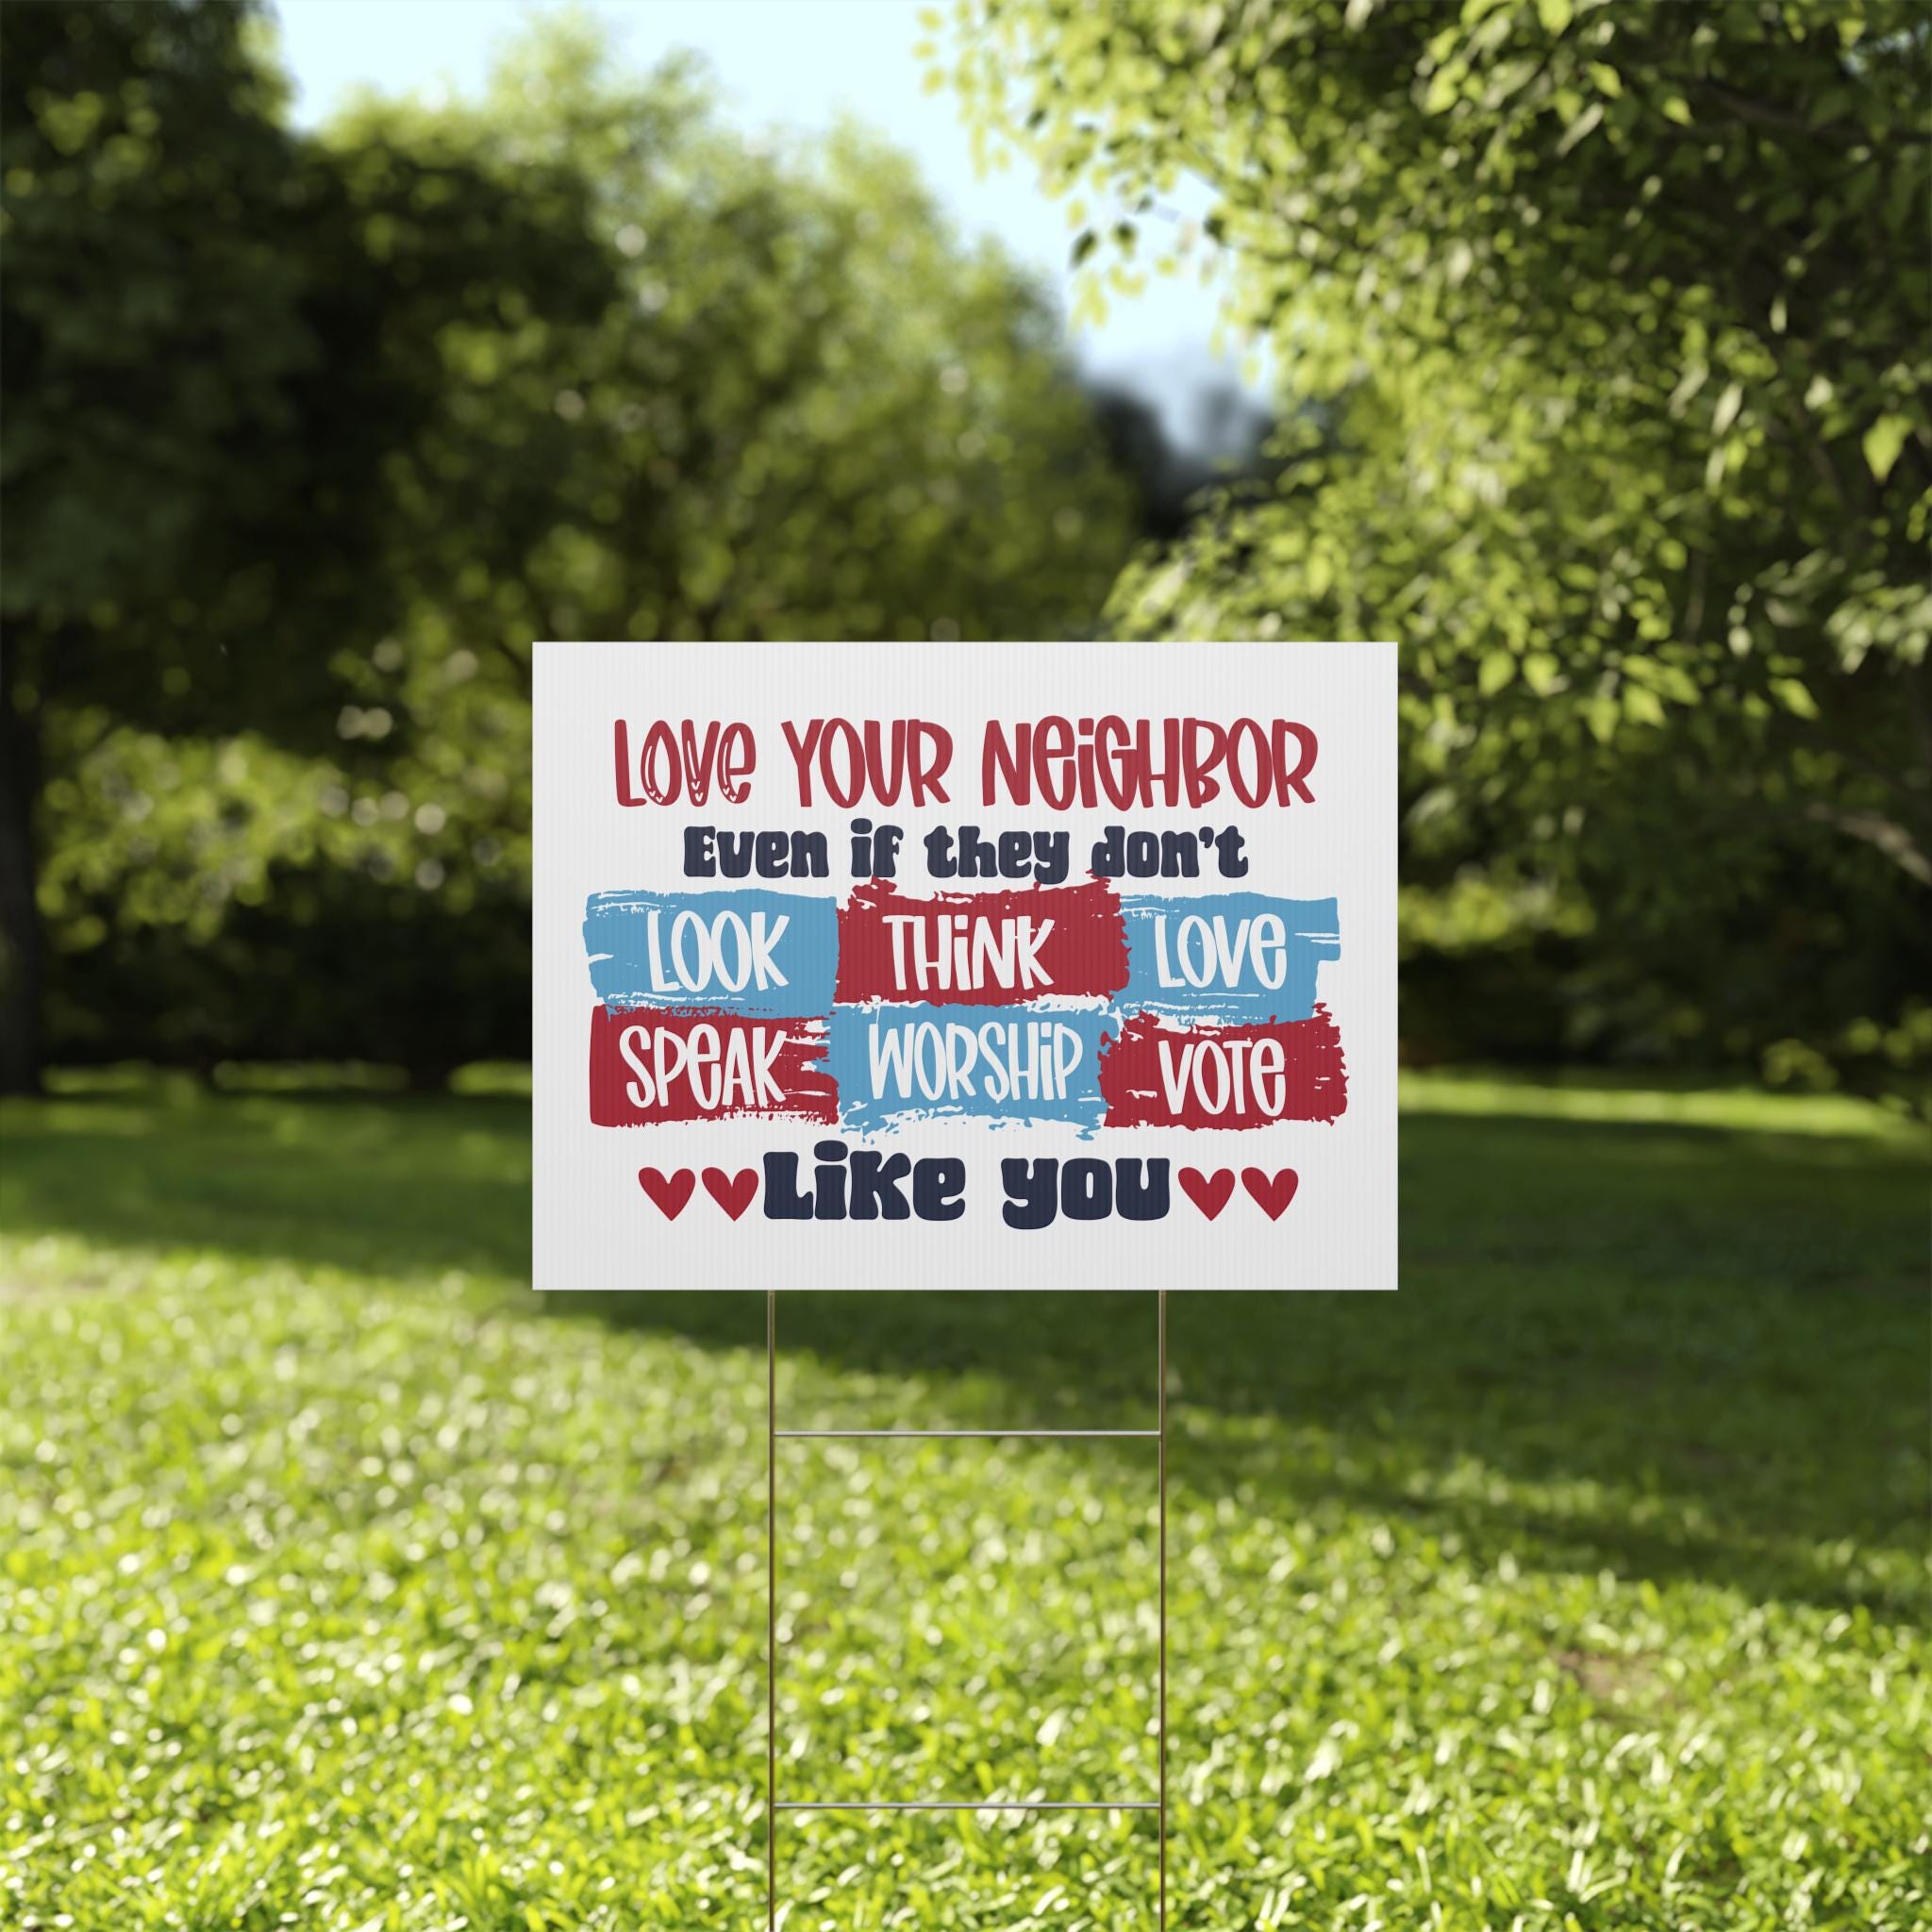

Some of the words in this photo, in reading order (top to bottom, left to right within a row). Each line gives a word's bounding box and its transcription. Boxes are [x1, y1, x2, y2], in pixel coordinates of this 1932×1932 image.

[781, 718, 954, 808] YOUR
[683, 825, 829, 878] Even
[850, 818, 904, 878] if
[924, 825, 1070, 885] they
[1091, 825, 1249, 878] don't
[648, 910, 790, 992] LOOK
[762, 1140, 966, 1222] Like
[1000, 1158, 1171, 1230] you
